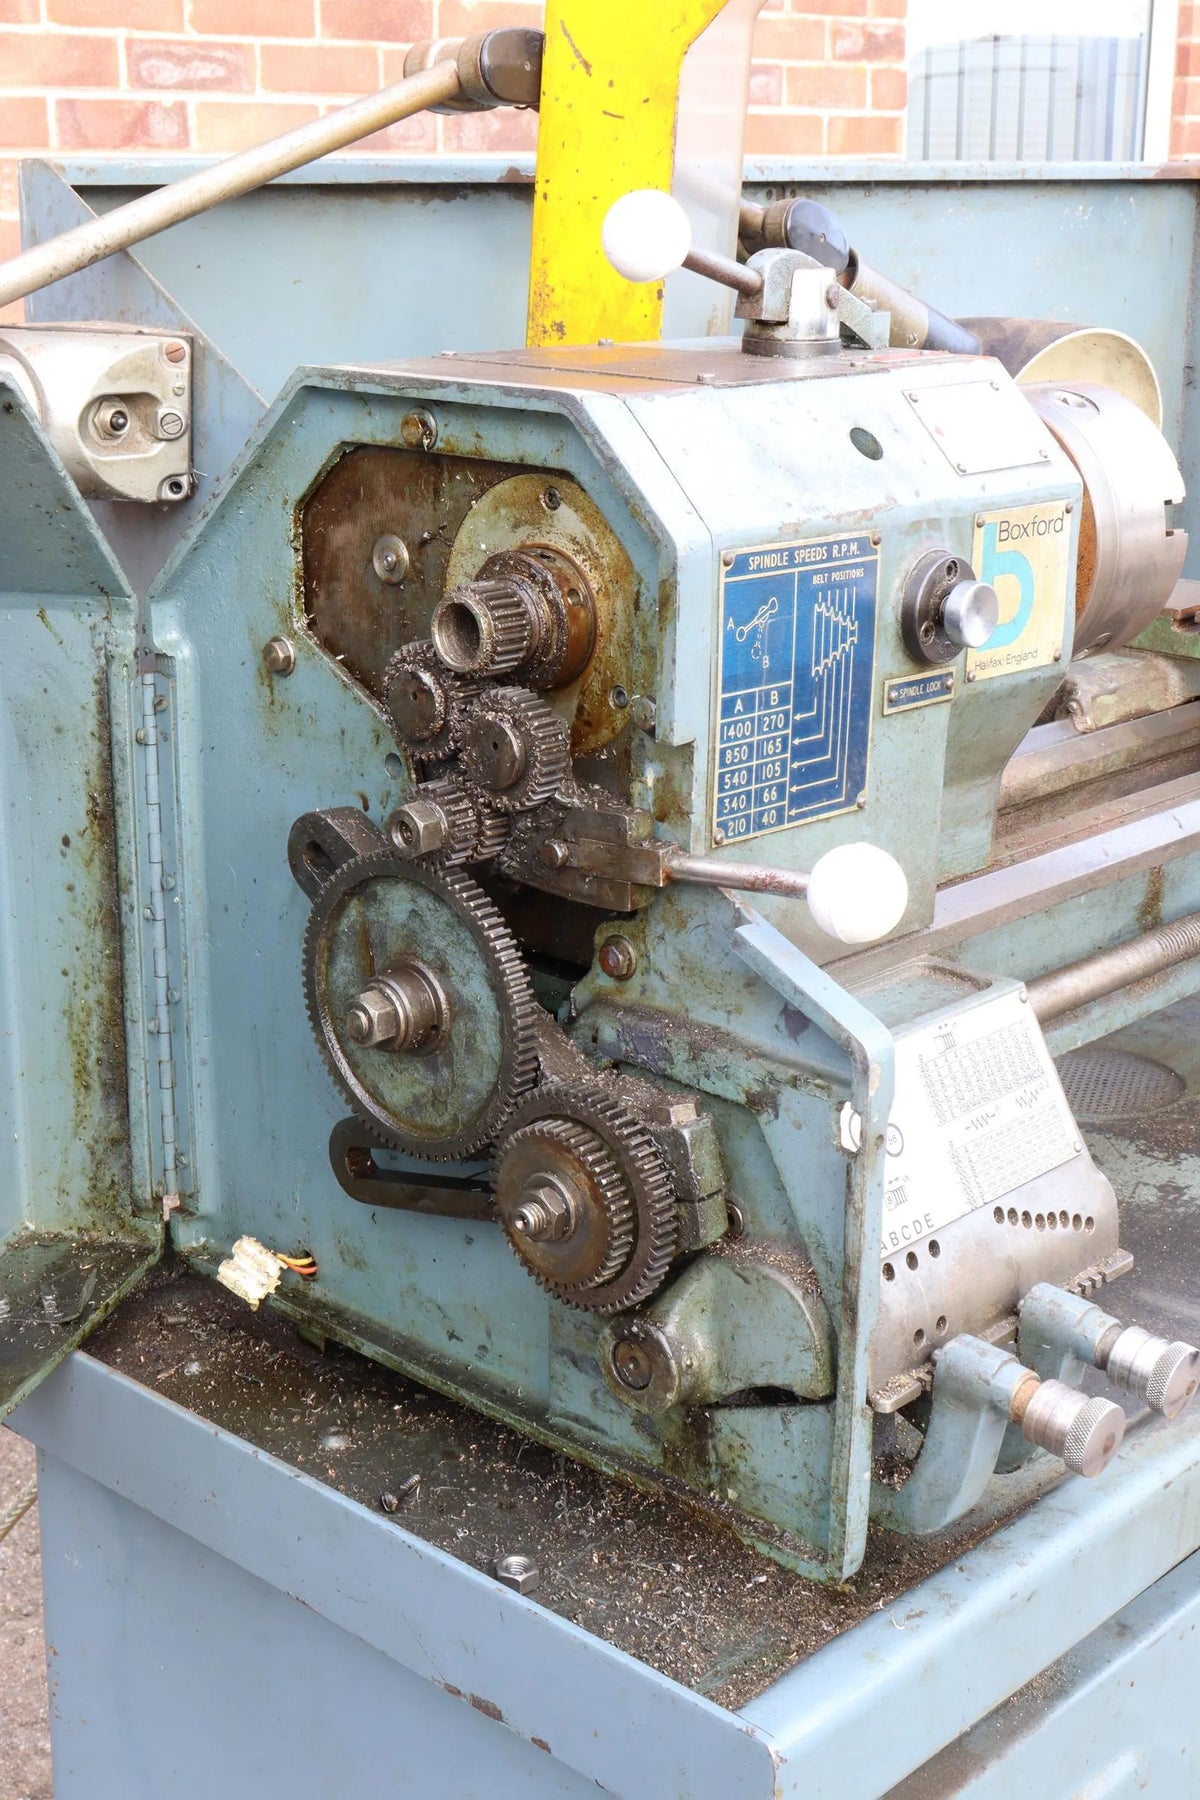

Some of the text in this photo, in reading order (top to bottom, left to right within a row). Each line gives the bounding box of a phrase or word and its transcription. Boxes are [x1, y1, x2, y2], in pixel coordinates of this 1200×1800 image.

[998, 511, 1064, 542] Boxford
[748, 541, 860, 571] SPINDLE SPEEDS R.P.M.
[812, 568, 865, 585] BELT POSITIONS
[726, 616, 735, 631] A
[762, 655, 769, 669] B
[974, 648, 1038, 672] Halifax England
[734, 690, 779, 714] A B
[899, 680, 942, 699] SPINDLE LOCK
[723, 713, 785, 741] 1400 270
[725, 737, 782, 765] 850 165
[724, 762, 781, 790] 540 105
[723, 786, 777, 814] 340 66
[727, 809, 776, 837] 210 40
